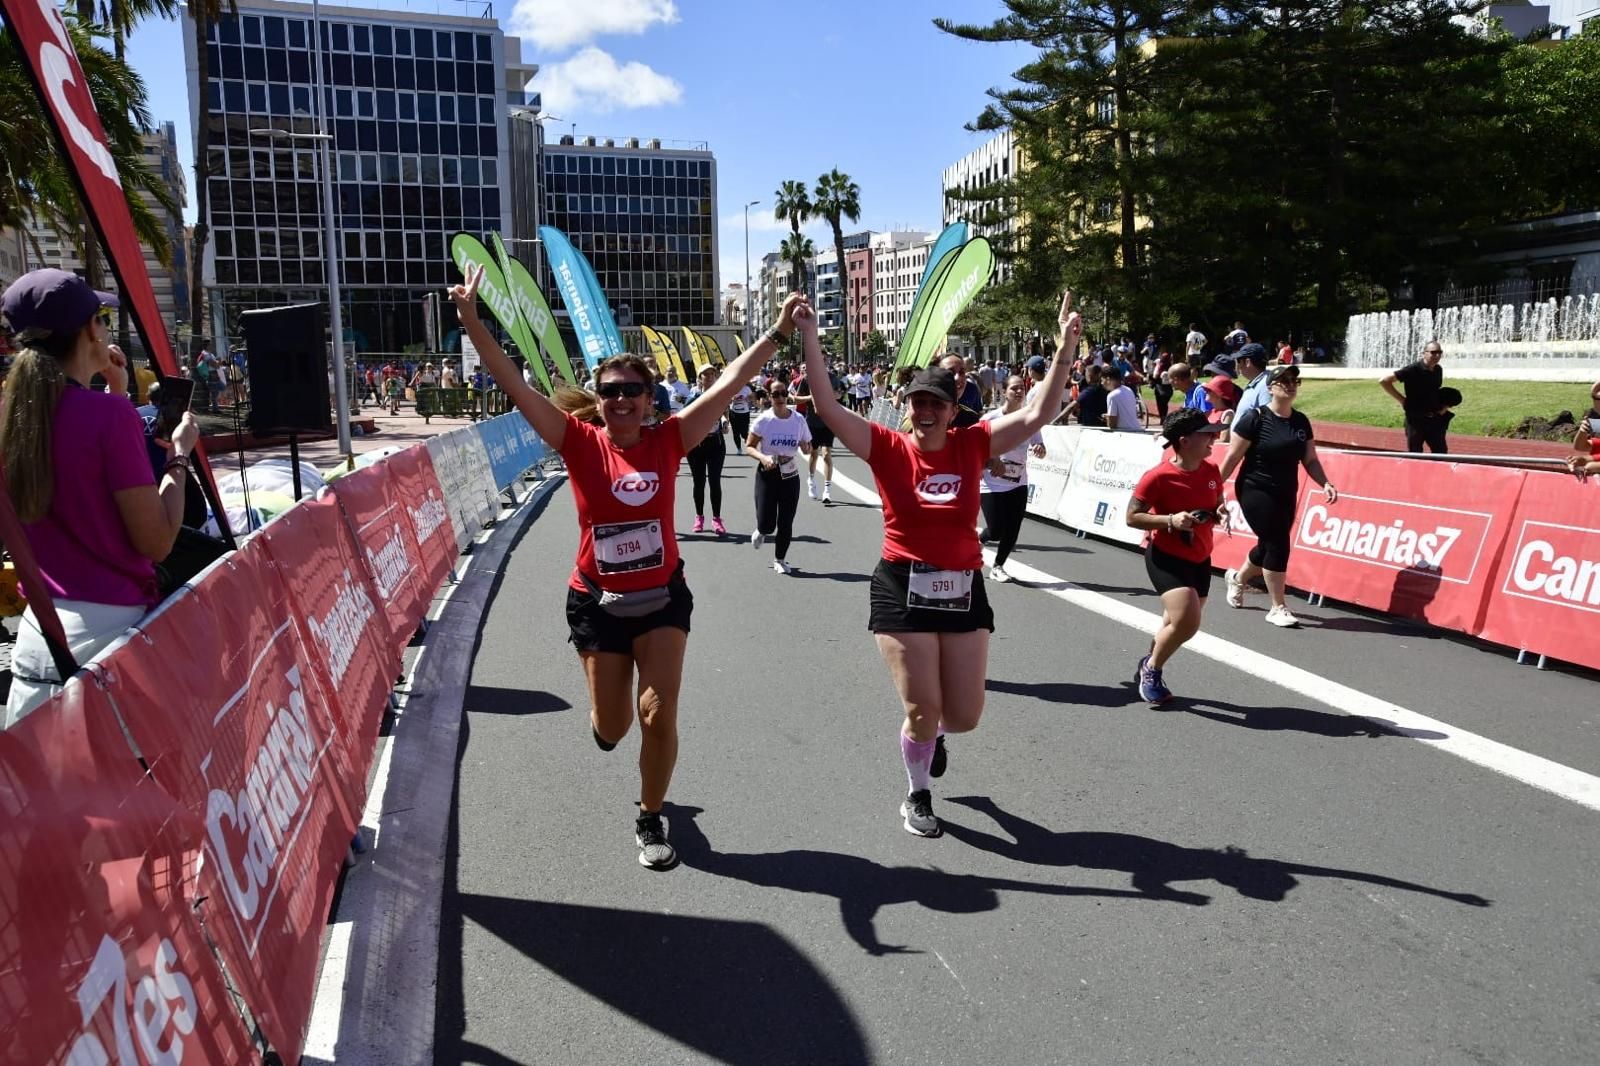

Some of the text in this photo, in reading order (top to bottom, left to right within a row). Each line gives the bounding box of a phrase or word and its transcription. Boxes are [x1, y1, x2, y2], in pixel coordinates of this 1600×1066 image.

[942, 265, 979, 328] Binter
[770, 439, 798, 447] KPMG
[1094, 454, 1117, 473] Gran
[1301, 504, 1462, 569] Canarias7
[616, 539, 641, 556] 5794
[932, 580, 954, 592] 5791
